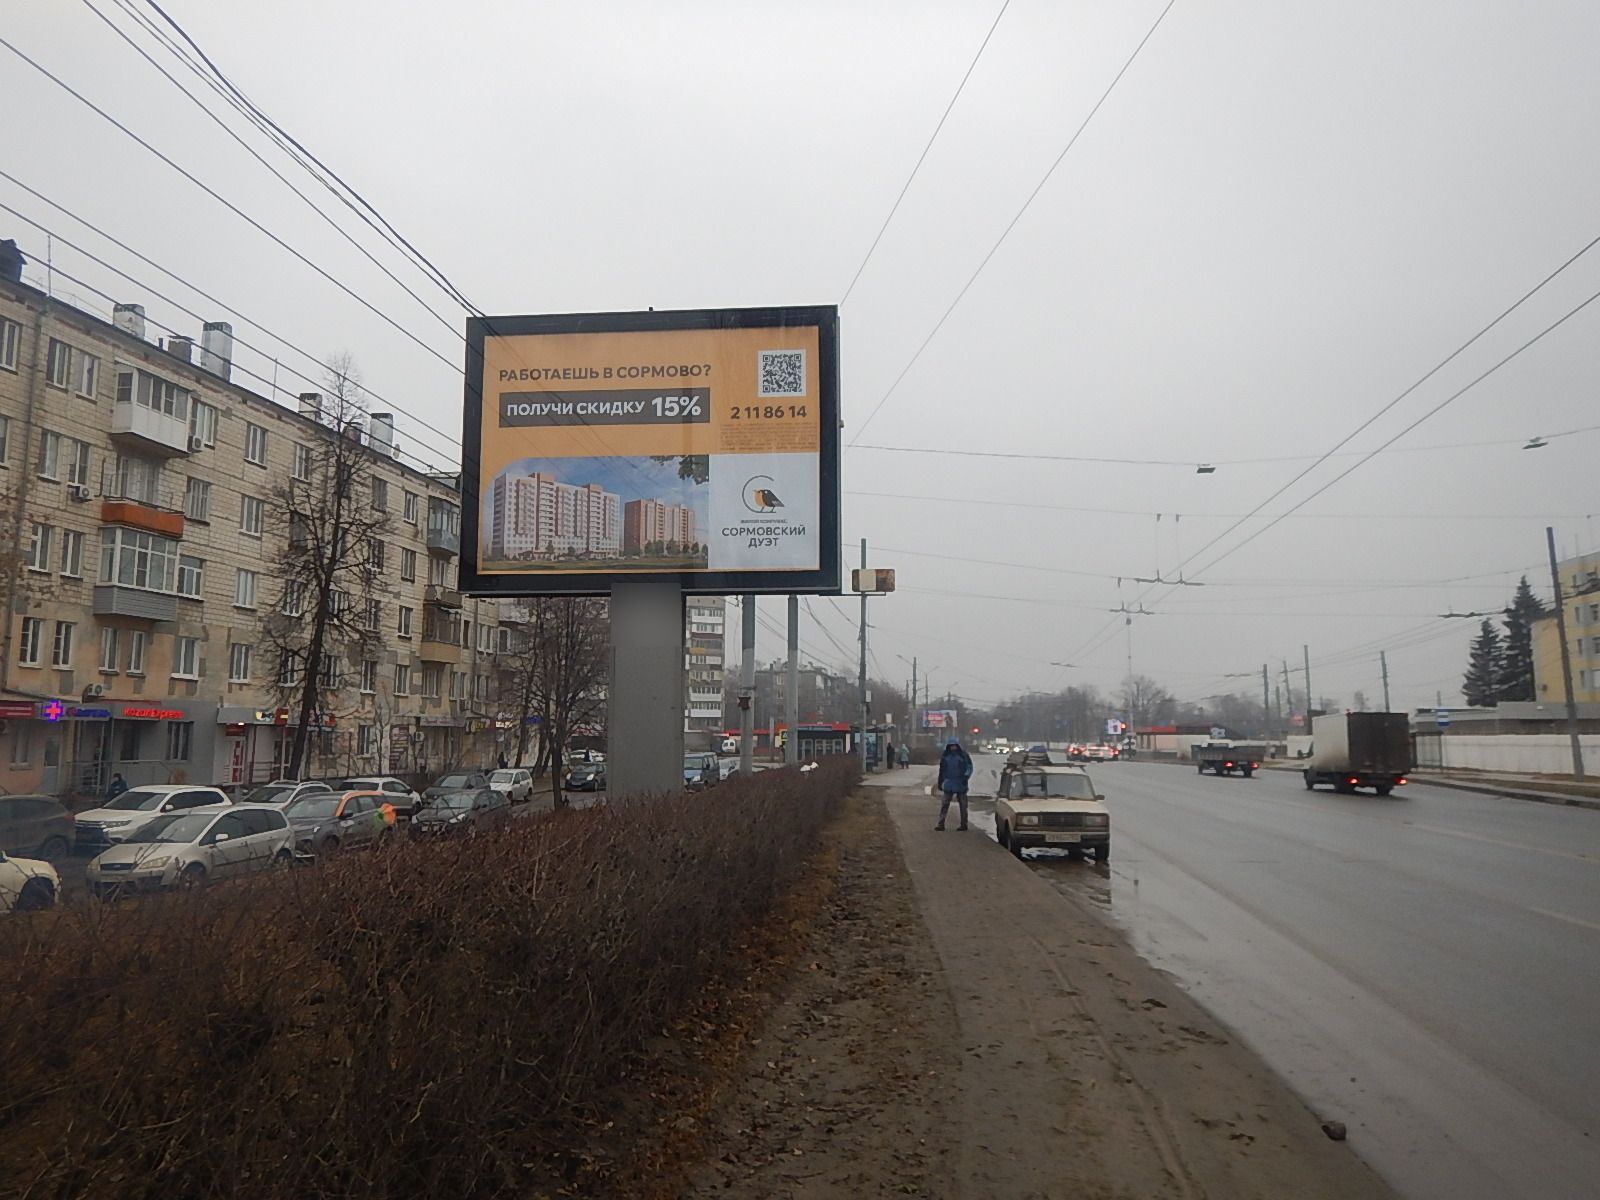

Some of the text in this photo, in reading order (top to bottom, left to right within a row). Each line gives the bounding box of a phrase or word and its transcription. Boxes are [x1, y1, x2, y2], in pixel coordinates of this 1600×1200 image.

[499, 364, 712, 382] РАБОТАЕШЬ В СОРМОВО?
[506, 395, 702, 417] ПОЛУЧИ СКИДКУ 15%
[730, 405, 808, 419] 2 11 86 14
[721, 524, 807, 537] СОРМОВСКИЙ
[747, 537, 780, 549] ДУЭТ
